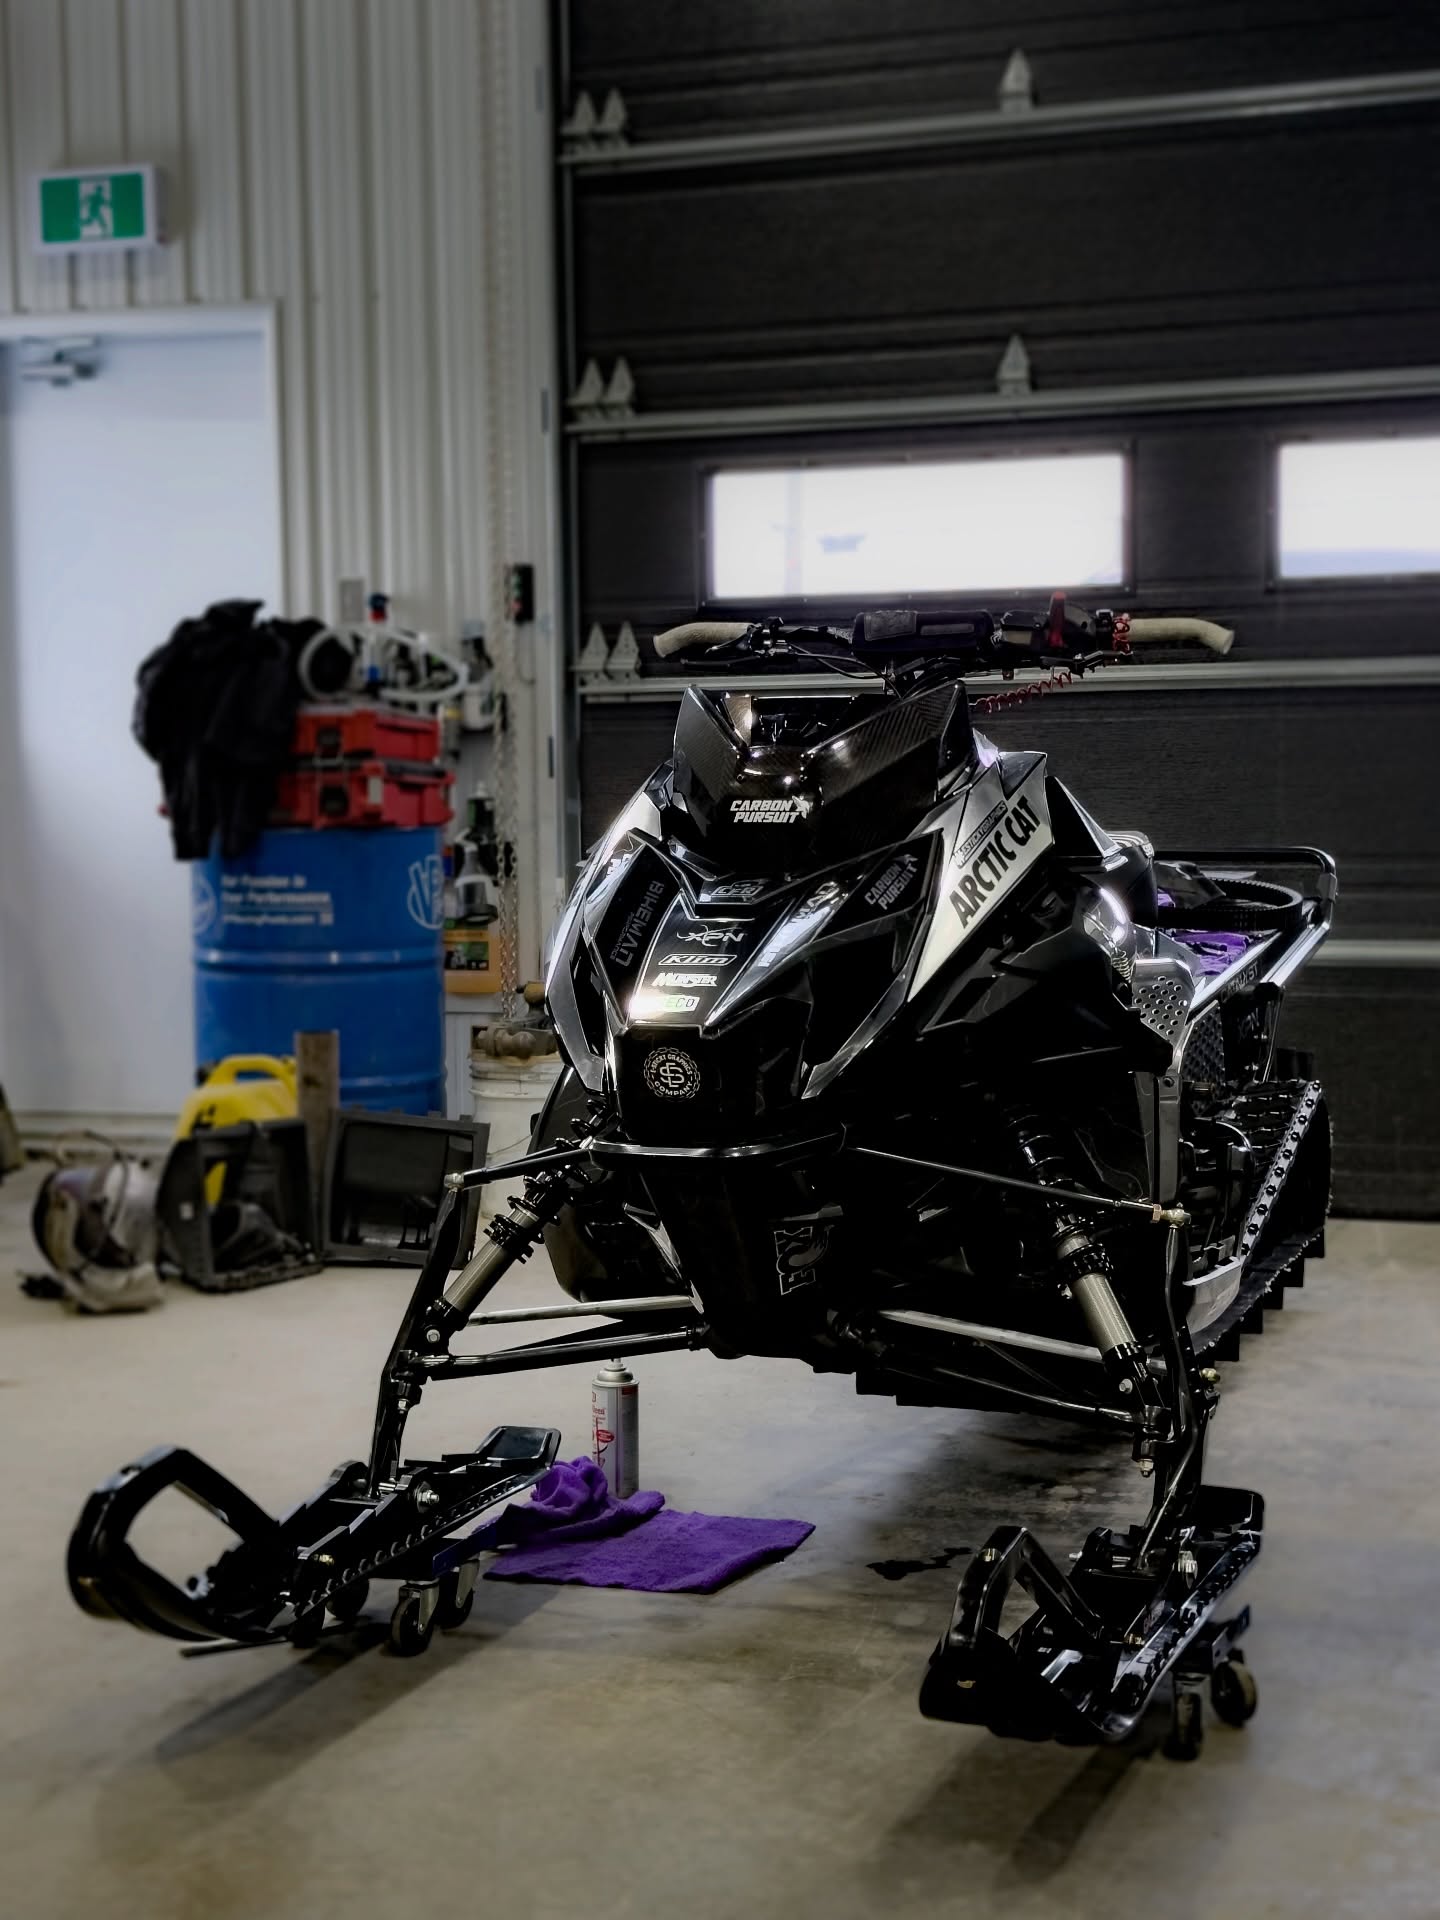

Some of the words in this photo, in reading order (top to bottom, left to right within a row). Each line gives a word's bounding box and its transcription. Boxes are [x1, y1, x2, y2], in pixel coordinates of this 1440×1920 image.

[730, 799, 794, 812] CARBON
[733, 811, 800, 823] PURSUIT
[950, 830, 1017, 929] ARCTIC
[1004, 795, 1041, 847] CAT
[864, 863, 903, 905] CARBON
[877, 862, 918, 910] PURSUIT
[654, 1080, 693, 1096] COMPANY
